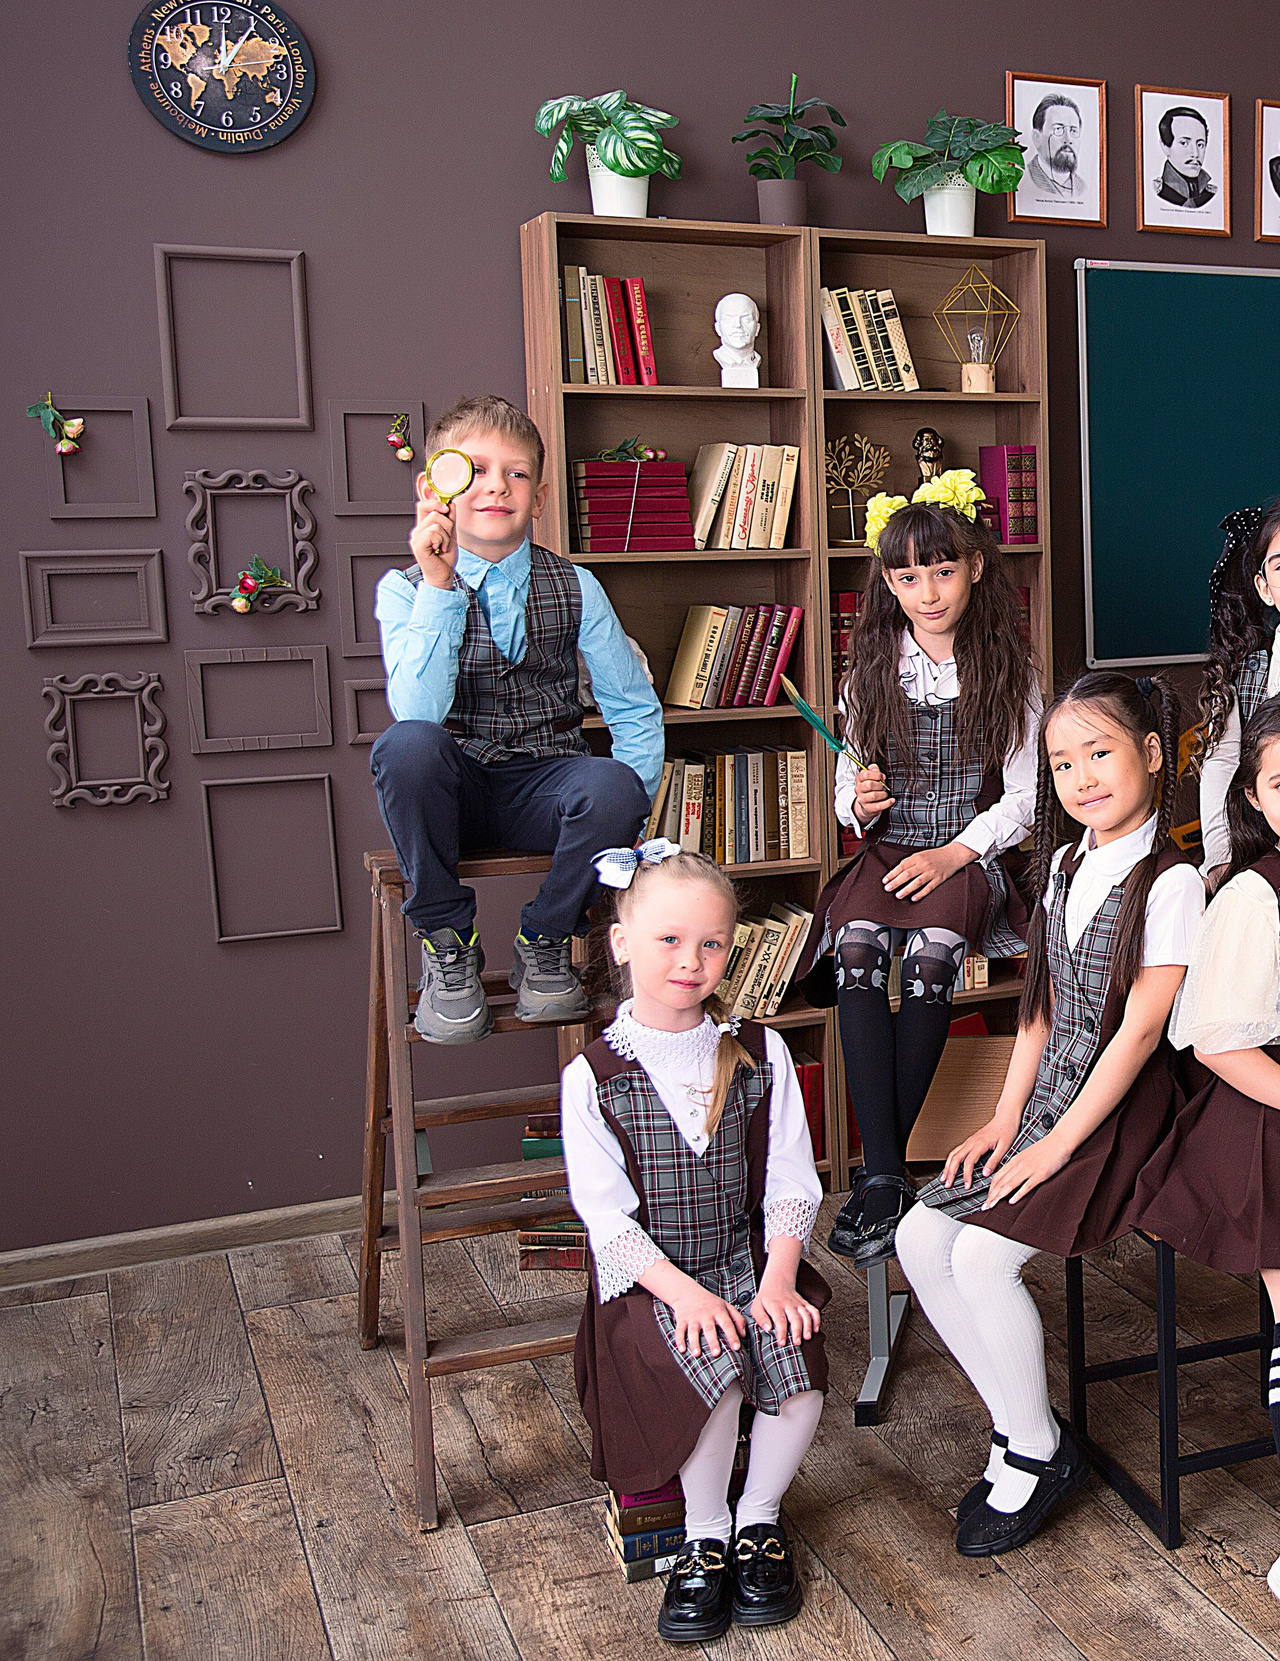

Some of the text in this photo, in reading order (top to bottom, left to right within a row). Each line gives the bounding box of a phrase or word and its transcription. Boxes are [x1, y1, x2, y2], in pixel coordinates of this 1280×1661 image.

[184, 8, 203, 26] 11
[212, 6, 232, 24] 12
[260, 5, 288, 34] Paris
[164, 26, 184, 42] 10
[140, 27, 156, 72] Athens
[268, 37, 280, 53] 2
[159, 52, 172, 69] 9
[287, 40, 308, 89] London
[276, 63, 288, 81] 3
[170, 81, 183, 99] 8
[272, 89, 284, 105] 4
[149, 82, 209, 138] Melbourne
[194, 101, 205, 117] 7
[250, 107, 262, 123] 5
[269, 97, 303, 131] Vienna
[221, 111, 234, 127] 6
[218, 129, 264, 144] Dublin
[633, 283, 647, 324] Кристи
[624, 366, 630, 376] 3
[646, 366, 653, 376] 3
[705, 625, 718, 652] ЕГОРОВ
[692, 773, 703, 800] ФАДЕЕВ
[779, 760, 789, 851] ДОРИС ЛЕССИНГ
